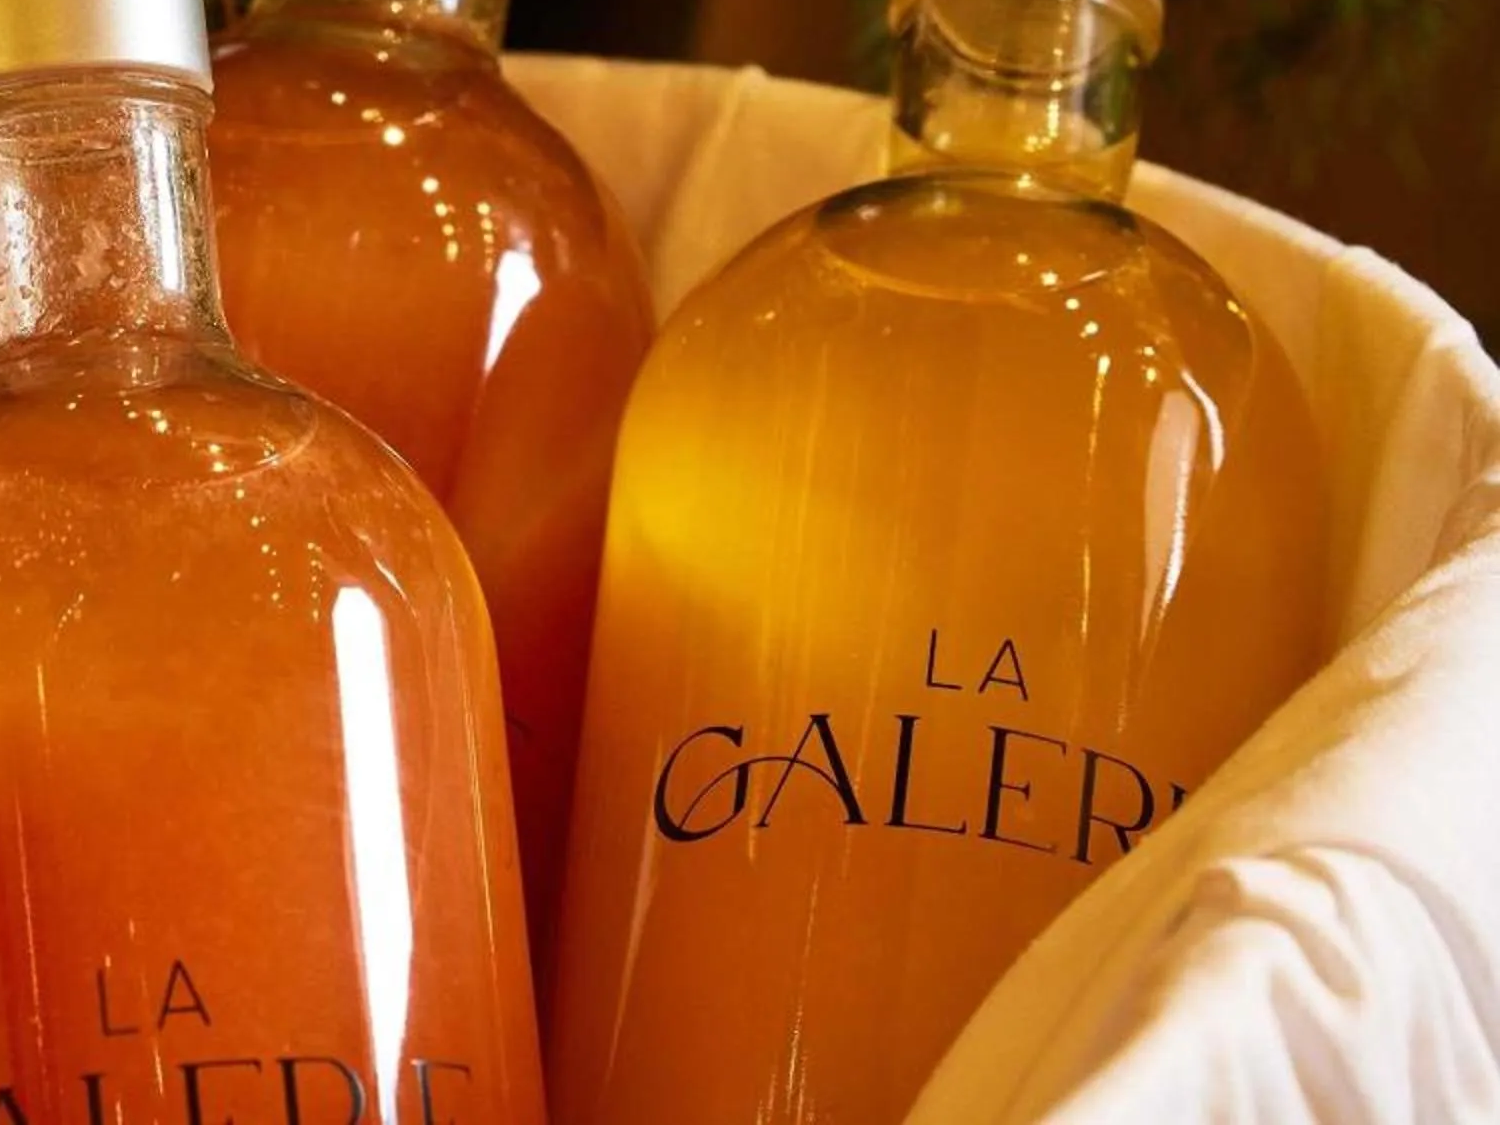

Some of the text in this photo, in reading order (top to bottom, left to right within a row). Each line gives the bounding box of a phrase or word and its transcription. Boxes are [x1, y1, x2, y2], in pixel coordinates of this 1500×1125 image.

[924, 627, 1029, 702] LA
[654, 713, 1188, 864] GALER
[96, 959, 212, 1037] LA
